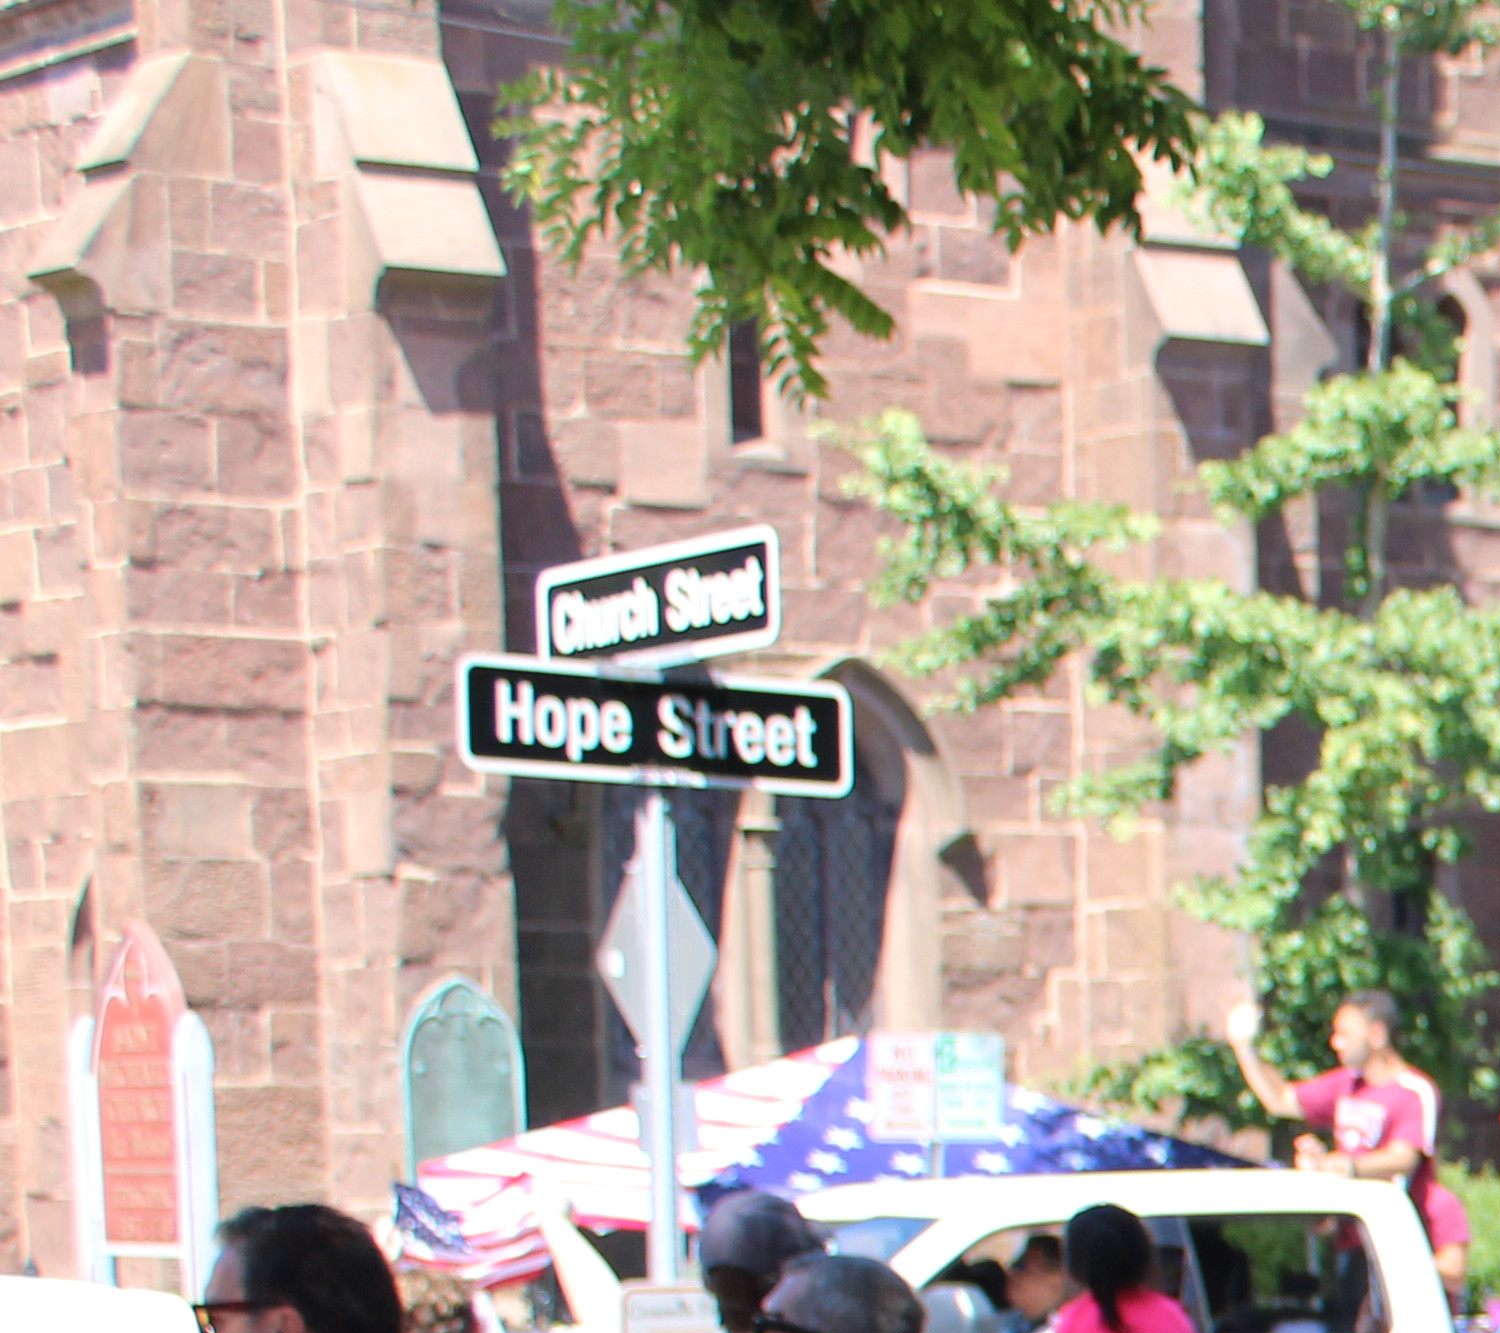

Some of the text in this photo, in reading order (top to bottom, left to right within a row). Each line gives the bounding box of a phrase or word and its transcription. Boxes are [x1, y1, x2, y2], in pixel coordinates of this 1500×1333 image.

[551, 554, 765, 655] Church Street
[494, 677, 819, 769] Hope Street
